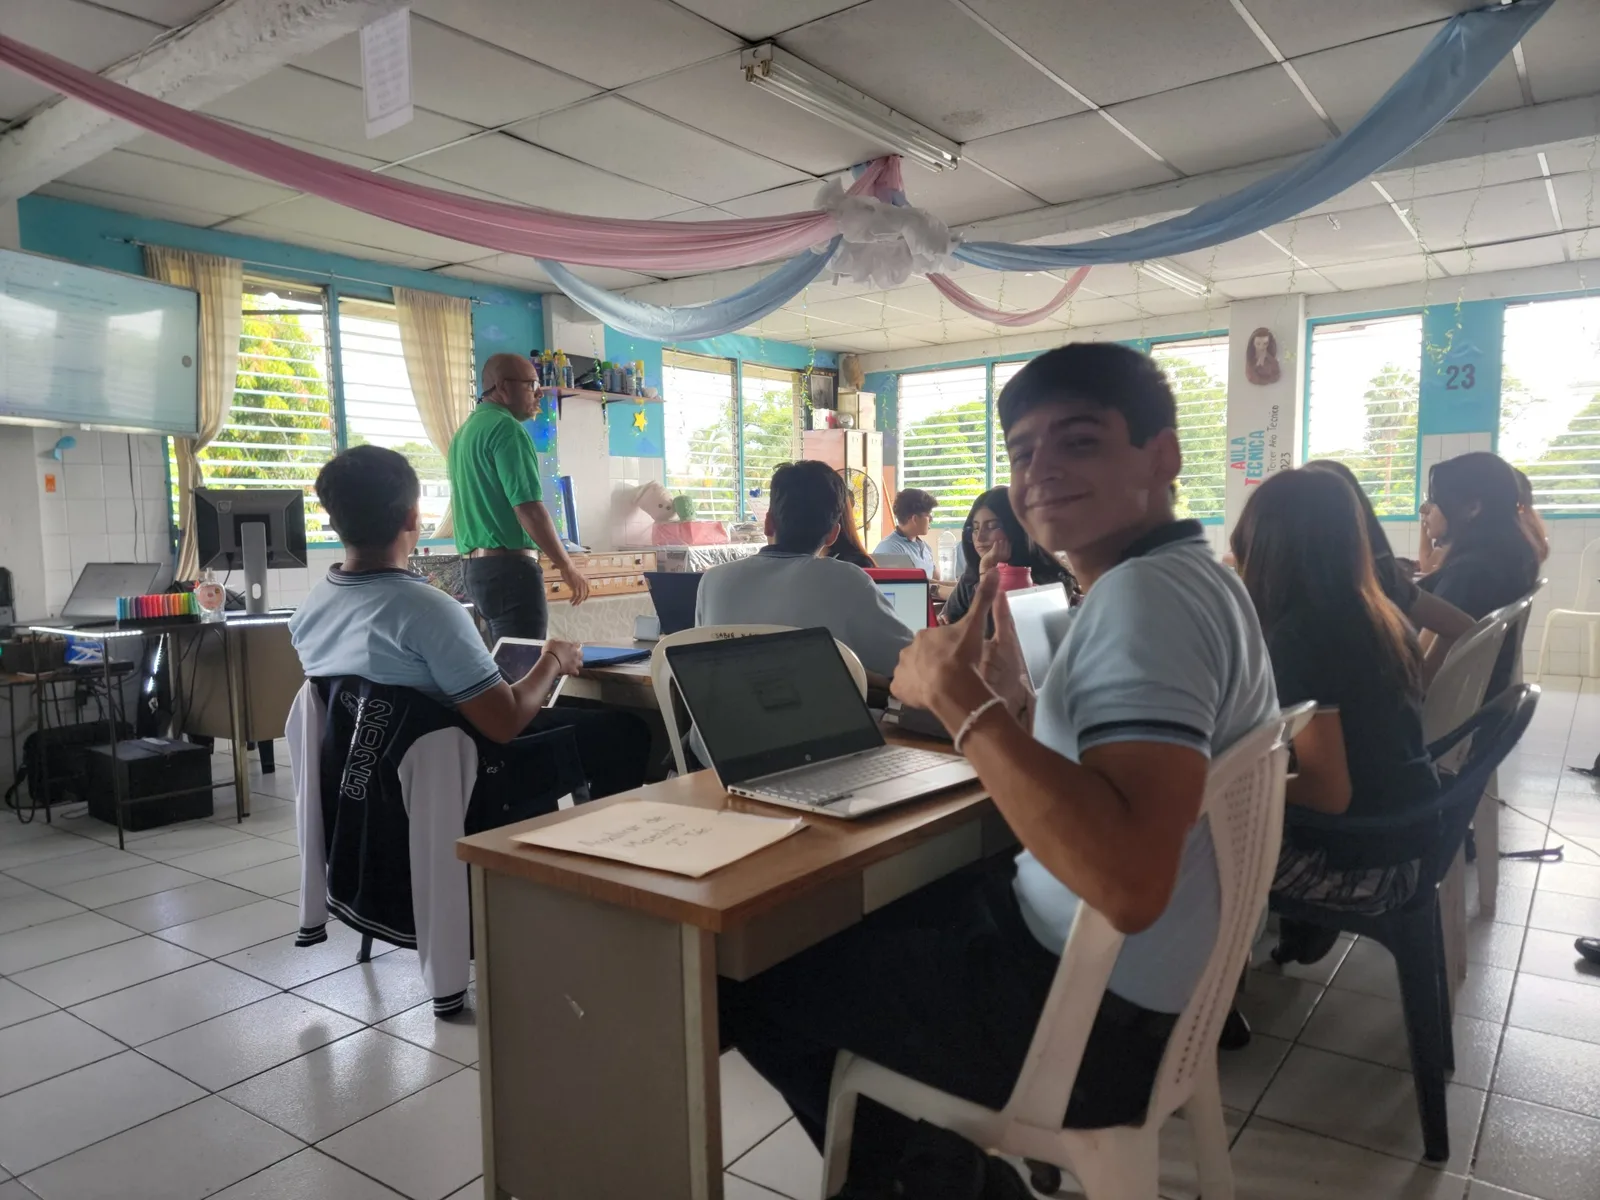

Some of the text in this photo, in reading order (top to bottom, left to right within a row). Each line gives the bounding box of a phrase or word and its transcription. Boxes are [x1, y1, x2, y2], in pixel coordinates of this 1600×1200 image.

[1446, 363, 1476, 390] 23
[1230, 437, 1247, 470] AULA
[1280, 452, 1292, 470] 023
[343, 698, 393, 800] 2025
